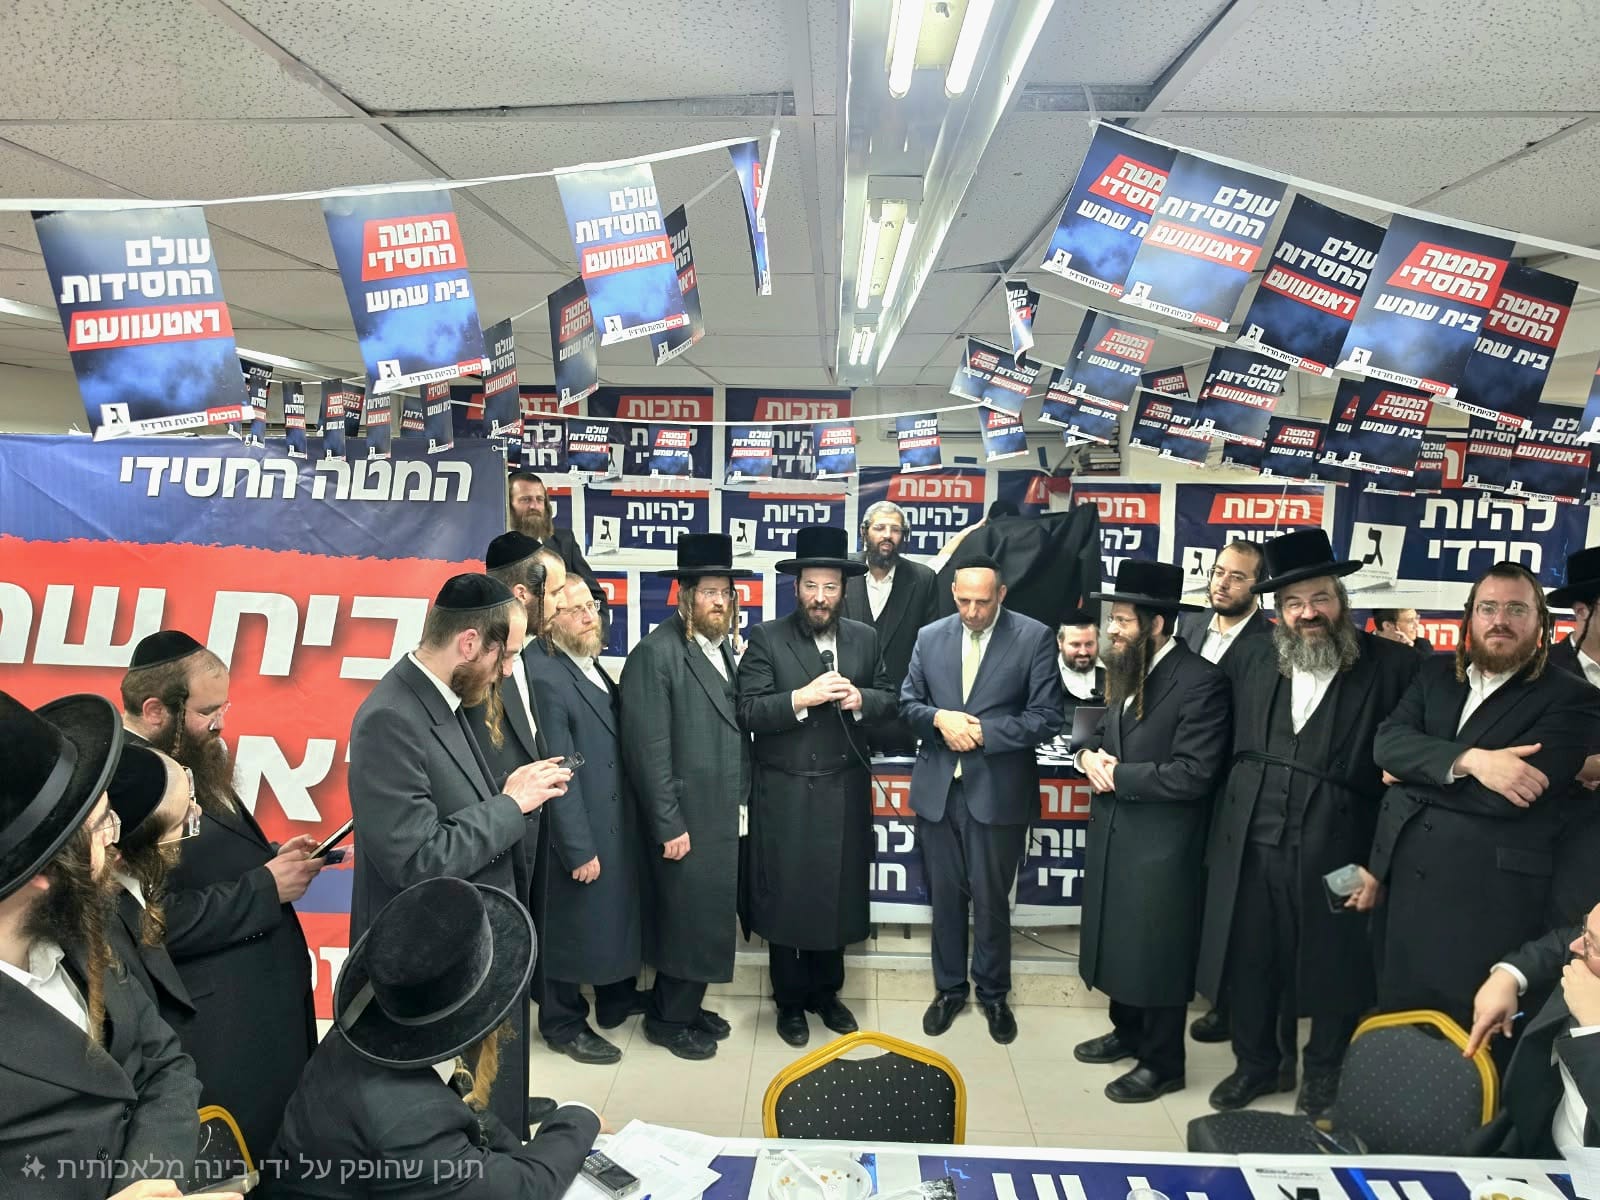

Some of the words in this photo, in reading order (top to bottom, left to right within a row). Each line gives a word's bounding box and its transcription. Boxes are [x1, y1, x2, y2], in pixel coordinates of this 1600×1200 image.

[1116, 161, 1167, 192] מטה
[609, 186, 657, 212] עולם
[1100, 176, 1160, 210] חסידי
[1212, 185, 1280, 217] עולם
[1077, 199, 1132, 231] שמש
[1159, 196, 1265, 240] החסידות
[378, 220, 450, 248] המטה
[576, 211, 661, 243] החסידות
[125, 236, 209, 266] עולם
[1150, 225, 1253, 265] ראטעוועט
[1321, 236, 1377, 269] עולם
[368, 244, 456, 272] החסידי
[586, 241, 668, 273] ראטעוועט
[1275, 241, 1367, 290] החסידות
[1421, 248, 1496, 281] המטה
[61, 269, 213, 303] החסידות
[434, 278, 470, 302] בית
[1265, 268, 1355, 314] ראטעוועט
[1400, 266, 1488, 301] החסידי
[365, 284, 429, 313] שמש
[1373, 293, 1440, 321] שמש
[1497, 293, 1560, 325] המטה
[75, 309, 221, 344] ראטעוועט
[1439, 308, 1482, 333] בית
[1488, 309, 1553, 342] החסיד
[495, 336, 513, 356] עולם
[1474, 336, 1512, 359] שמ
[1088, 354, 1119, 371] שמש
[1120, 363, 1141, 376] בית
[1280, 353, 1299, 363] להיות
[1512, 349, 1550, 370] בית
[1216, 370, 1280, 393] החסידות
[1248, 363, 1287, 380] עולם
[1394, 374, 1418, 386] להיות
[627, 400, 700, 417] הזכות
[765, 402, 838, 420] הזכות
[1374, 404, 1425, 422] החסידי
[1384, 393, 1428, 410] המטה
[1477, 407, 1496, 418] להיות
[175, 415, 204, 425] להיות
[915, 419, 937, 430] עולם
[1360, 420, 1397, 435] שמש
[1500, 415, 1521, 425] הזכות
[569, 433, 607, 442] החסידות
[732, 438, 770, 447] החסידות
[749, 430, 772, 439] עולם
[898, 427, 936, 439] החסידות
[1399, 427, 1423, 439] בית
[1470, 429, 1515, 443] חסידות
[1270, 447, 1296, 455] שמש
[1297, 450, 1313, 458] בית
[1516, 445, 1585, 463] ראטעוועט
[119, 457, 298, 498] החסידי
[312, 459, 472, 501] המטה
[898, 479, 972, 497] הזכות
[626, 501, 694, 522] להיות
[763, 502, 830, 523] להיות
[1222, 498, 1310, 519] הזכות
[1420, 498, 1557, 531] להיות
[600, 520, 611, 541] ג
[737, 521, 747, 543] ג
[1363, 526, 1383, 567] ג
[1428, 539, 1543, 573] חרדי
[1191, 551, 1203, 575] ג
[206, 590, 429, 679] בית
